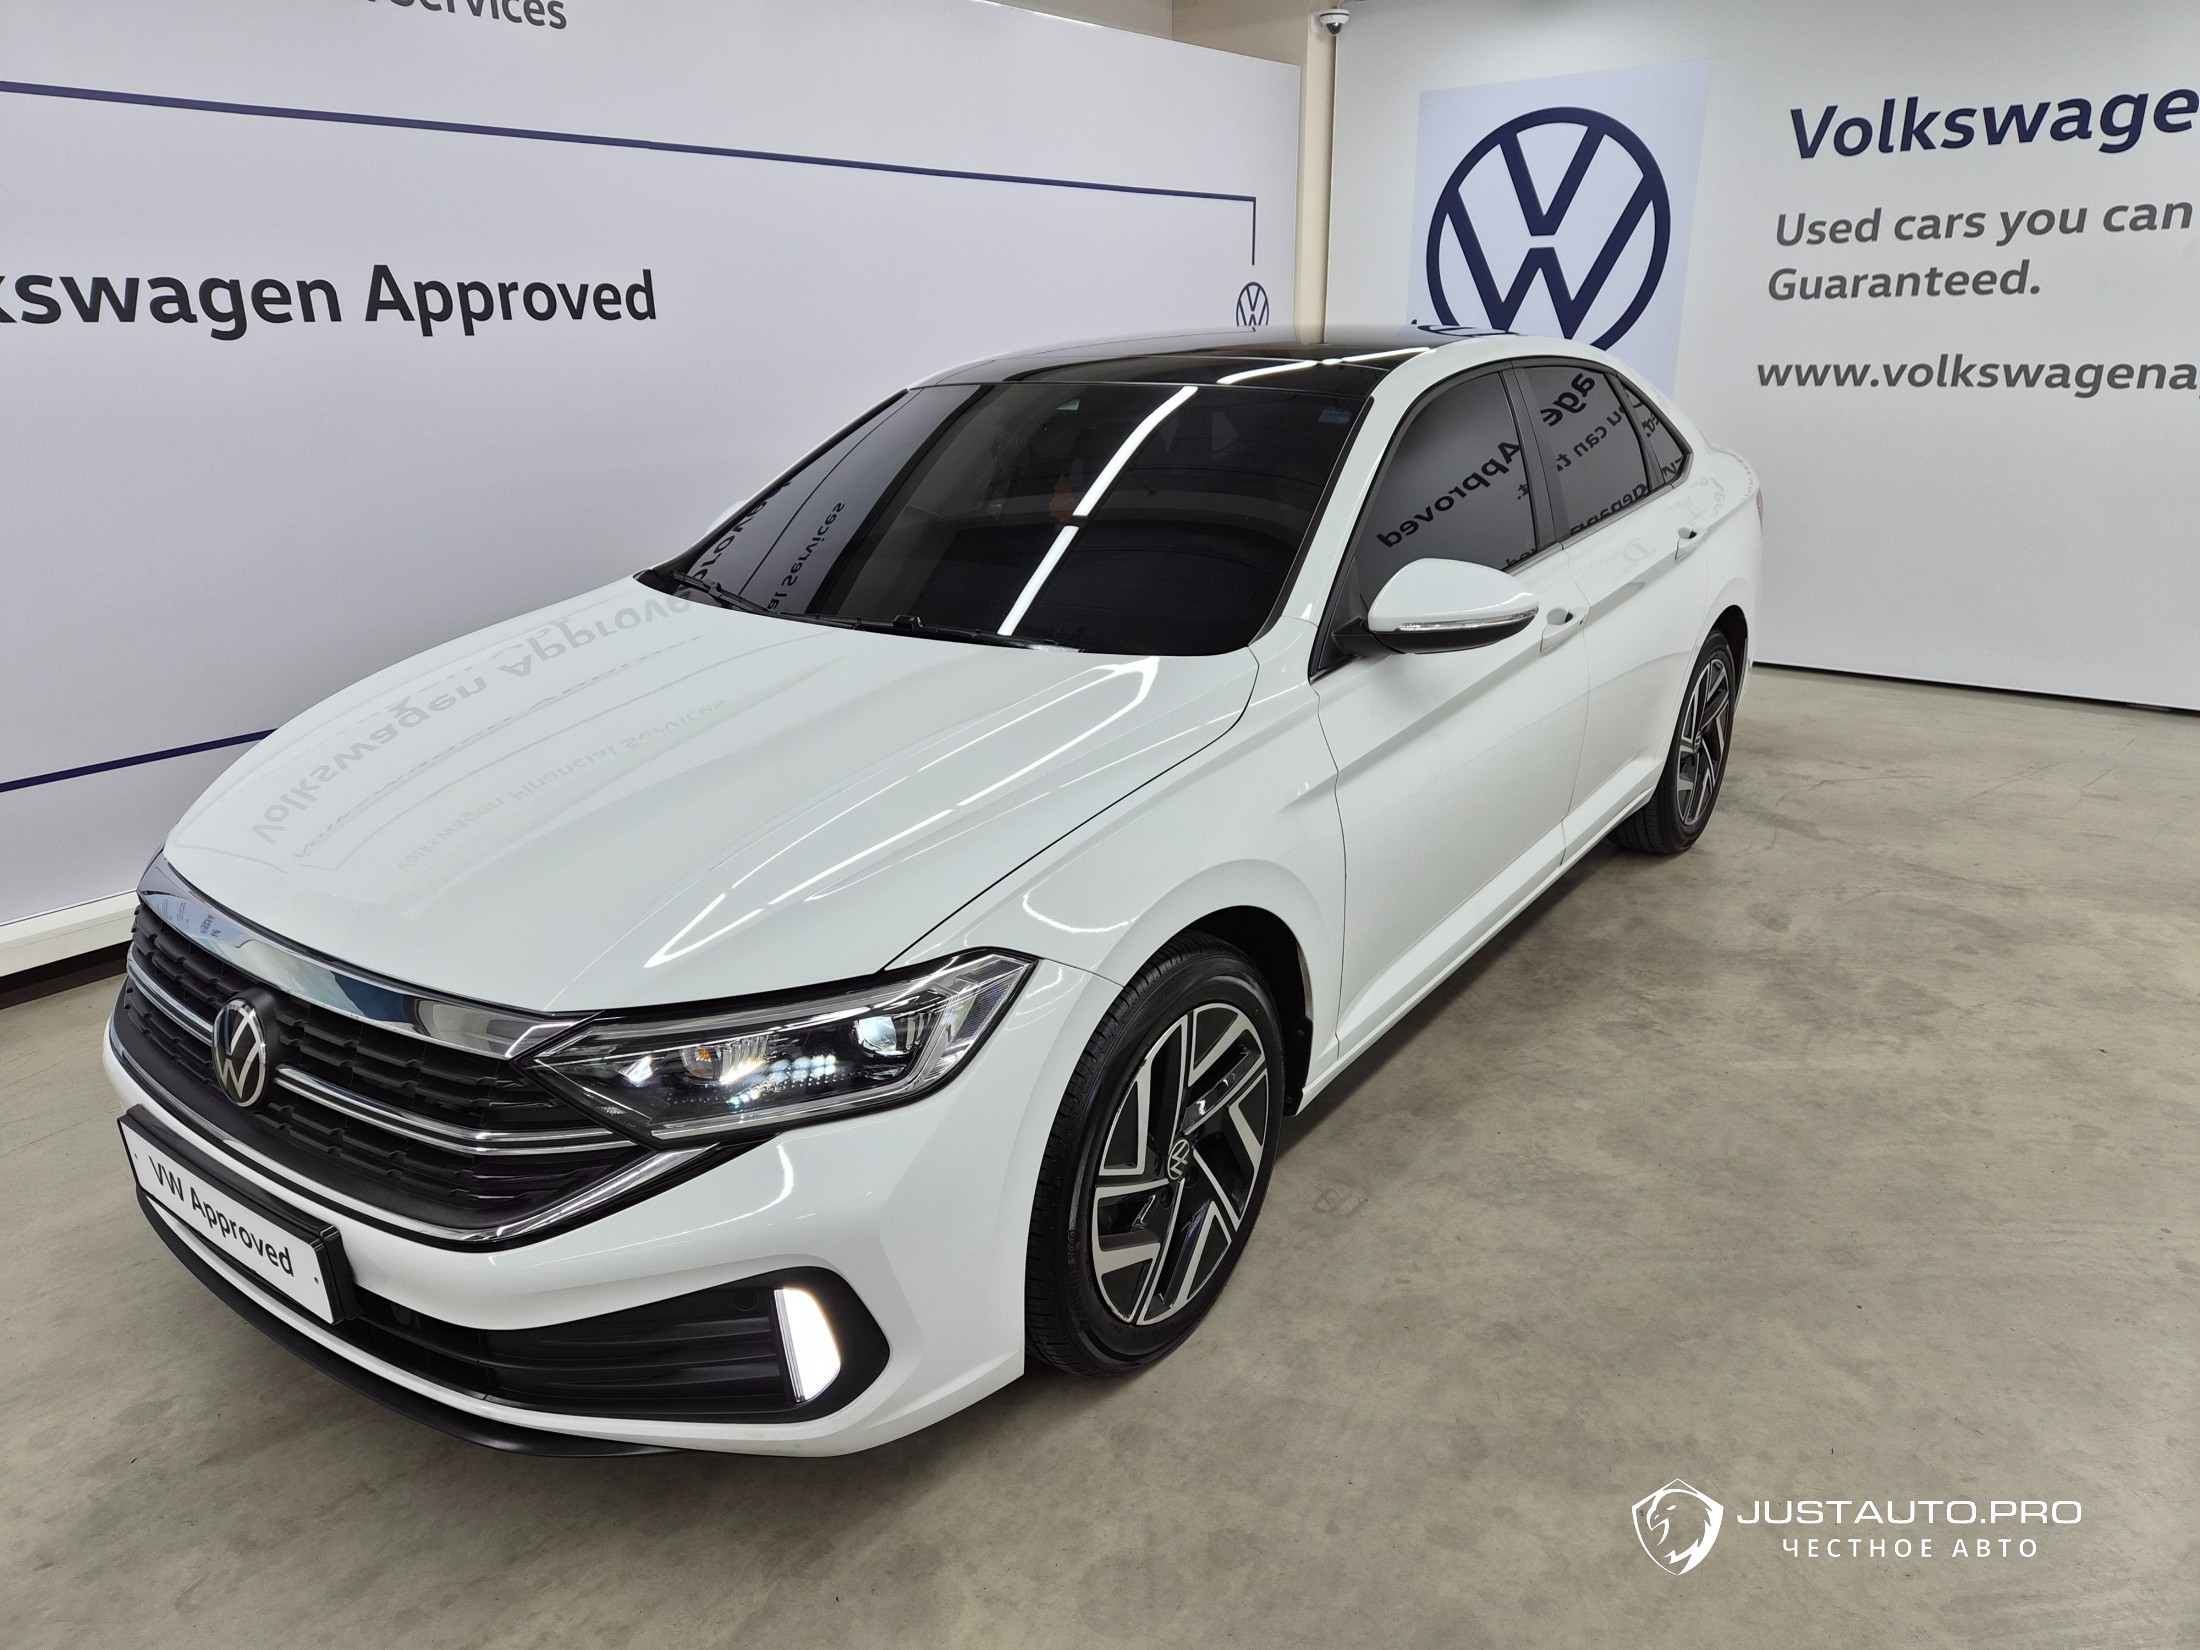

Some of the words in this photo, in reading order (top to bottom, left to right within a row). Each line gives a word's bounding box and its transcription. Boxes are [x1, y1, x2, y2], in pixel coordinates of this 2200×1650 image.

[1790, 87, 2200, 159] Volkswage
[1775, 207, 1882, 247] Used
[1893, 210, 1986, 241] cars
[1996, 206, 2088, 247] you
[2102, 201, 2194, 233] can
[364, 264, 657, 337] Approved
[1768, 259, 2042, 301] Guaranteed.
[1757, 353, 2199, 398] www.volkswagena
[148, 1155, 185, 1202] VW
[190, 1187, 295, 1277] Approved
